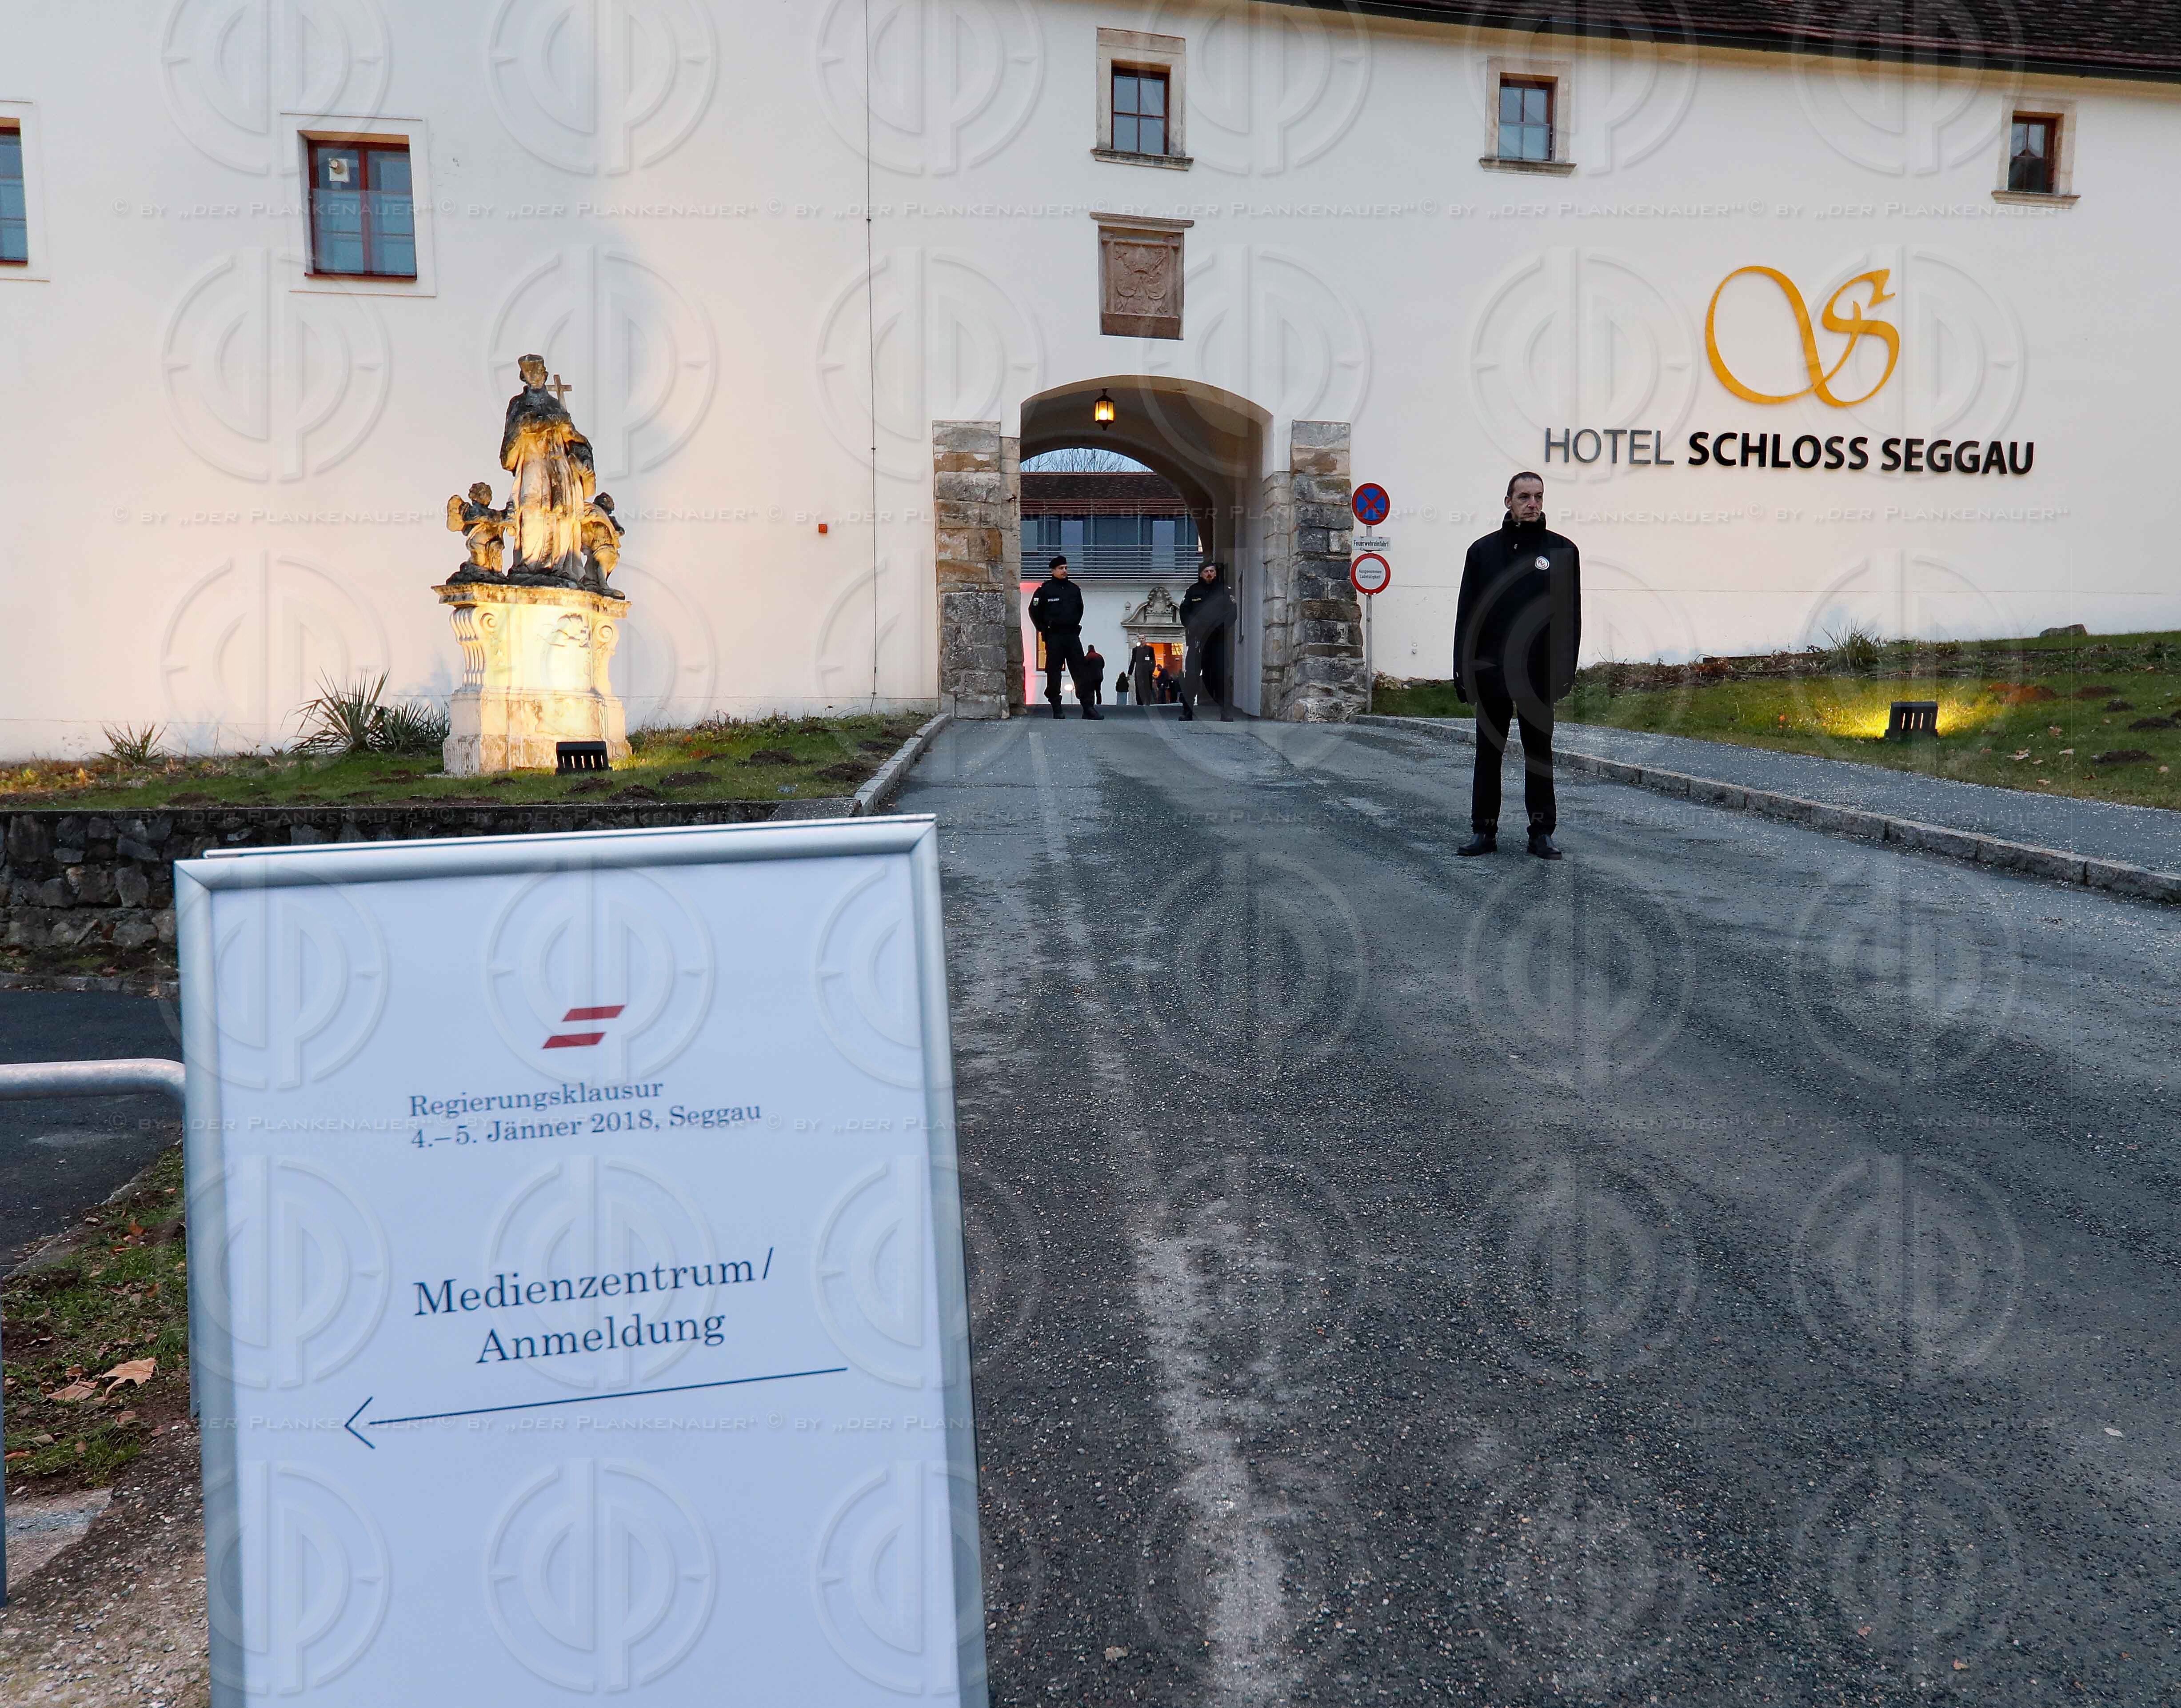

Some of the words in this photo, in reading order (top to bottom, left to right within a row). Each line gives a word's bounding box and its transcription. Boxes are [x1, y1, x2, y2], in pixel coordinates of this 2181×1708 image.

[1544, 427, 1675, 466] HOTEL
[1687, 431, 1869, 472] SCHLOSS
[1880, 438, 2034, 477] SEGGAU
[409, 1082, 664, 1119] Regierungsklausur
[487, 1121, 583, 1143] Jänner
[591, 1109, 660, 1133] 2018,
[668, 1105, 762, 1129] Seggau
[475, 1313, 726, 1364] Anmeldung
